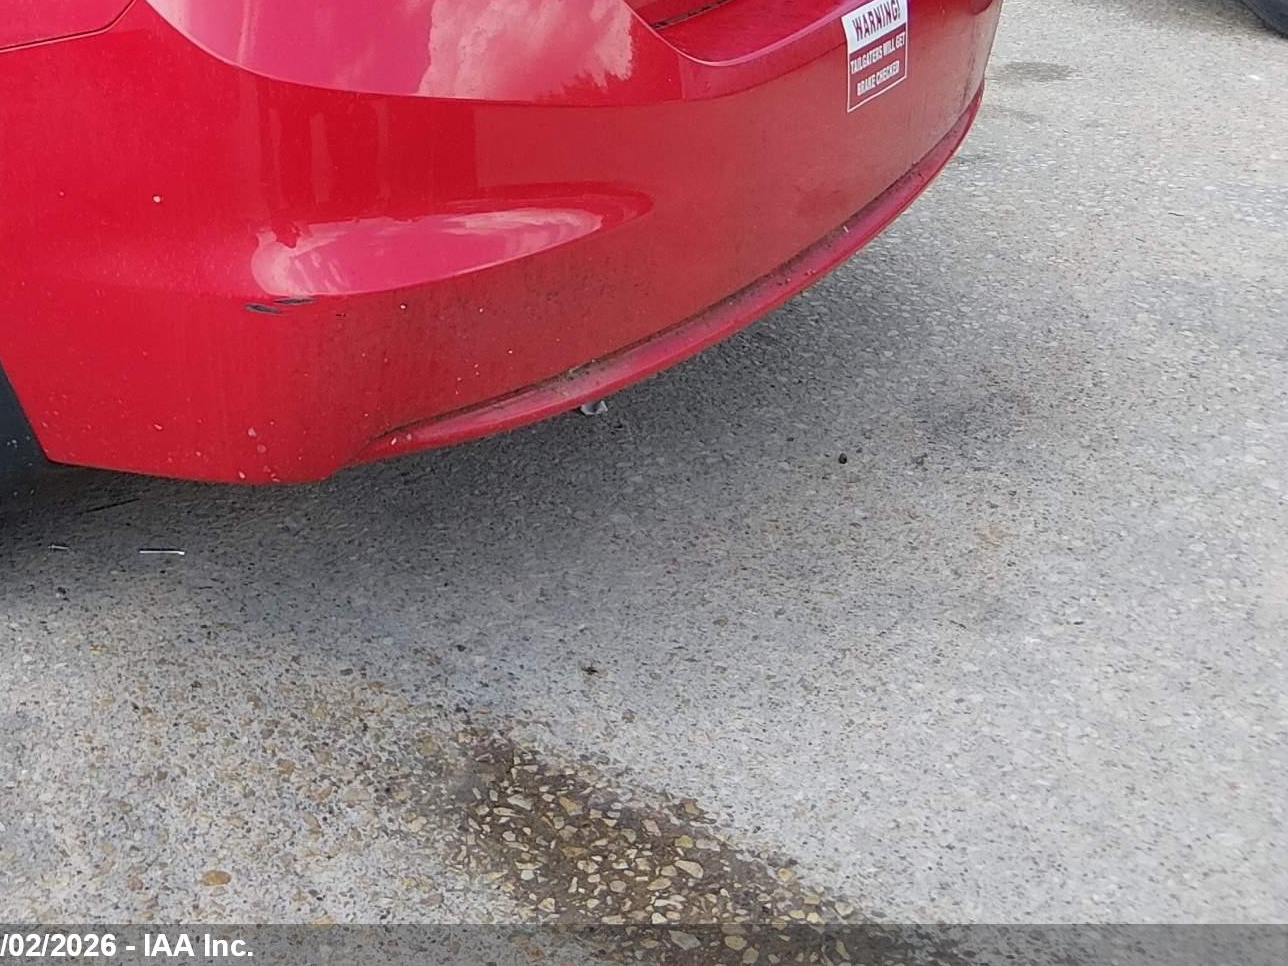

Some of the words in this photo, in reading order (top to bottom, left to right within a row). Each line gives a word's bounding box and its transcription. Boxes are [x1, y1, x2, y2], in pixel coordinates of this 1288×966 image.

[850, 45, 883, 75] TAILGATERS
[882, 38, 896, 57] WILL
[895, 32, 906, 51] GET
[856, 74, 876, 96] BRAKE
[875, 60, 900, 86] CHECKED
